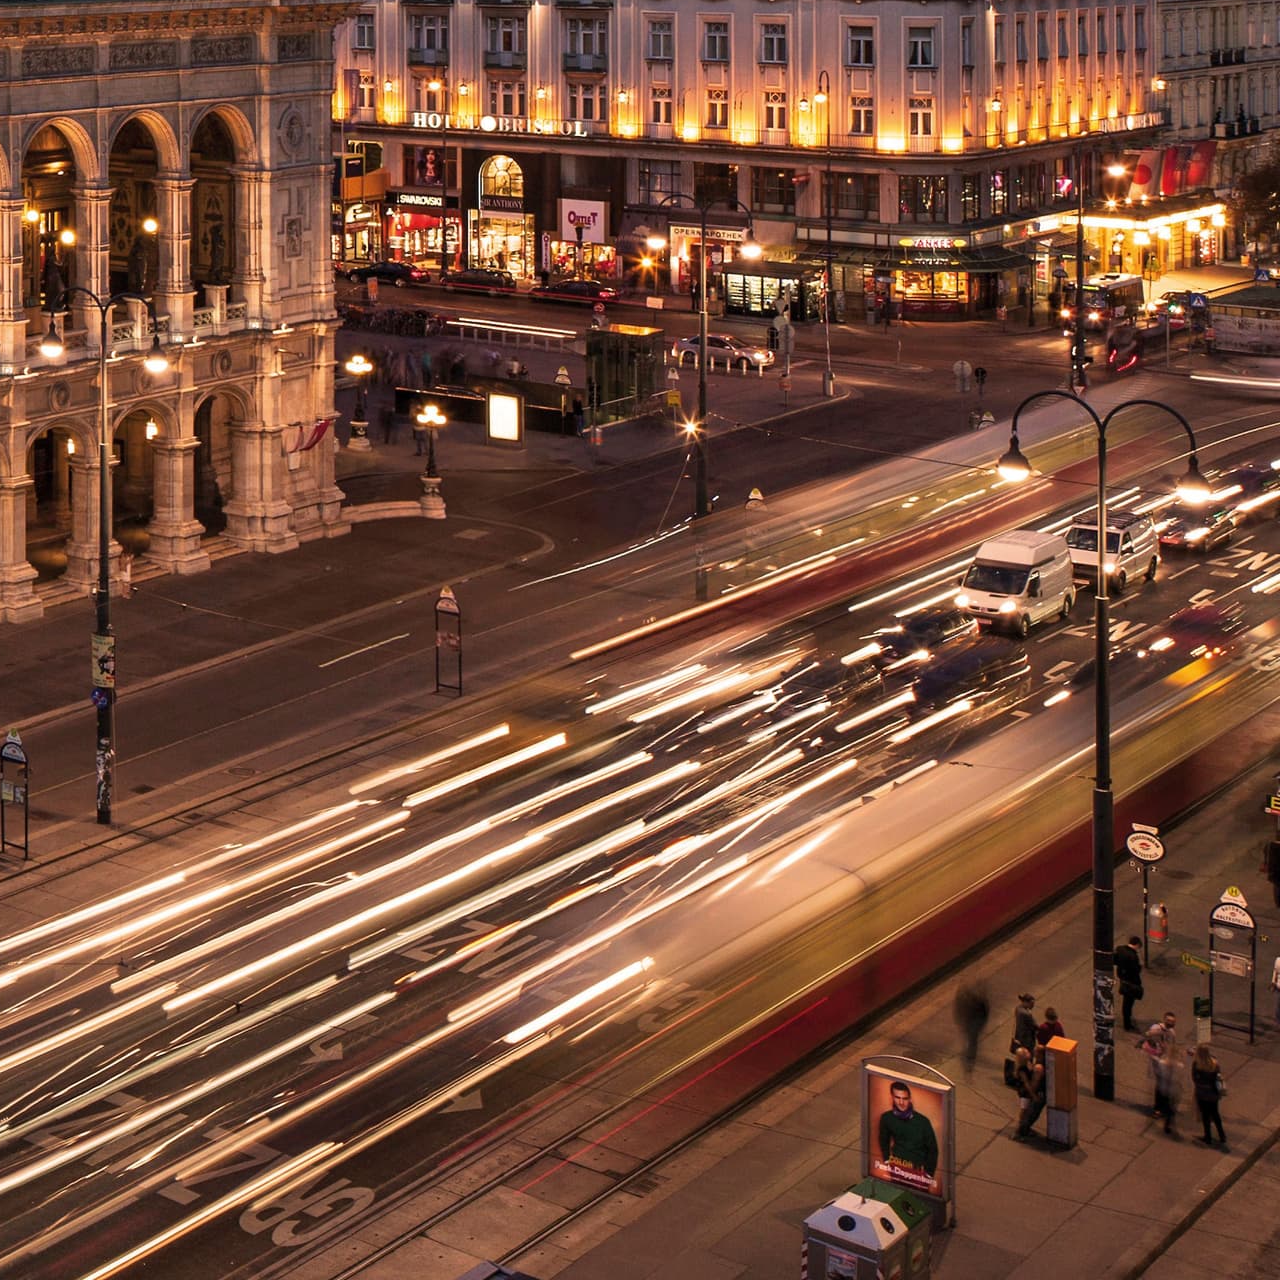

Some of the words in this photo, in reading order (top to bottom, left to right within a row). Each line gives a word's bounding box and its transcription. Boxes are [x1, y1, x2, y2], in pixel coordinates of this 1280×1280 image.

[413, 113, 480, 131] HOTEL
[498, 117, 588, 137] BRISTOL
[399, 194, 443, 206] SWAROVSKI
[492, 199, 524, 209] ANTHONY
[914, 238, 954, 249] ANKER
